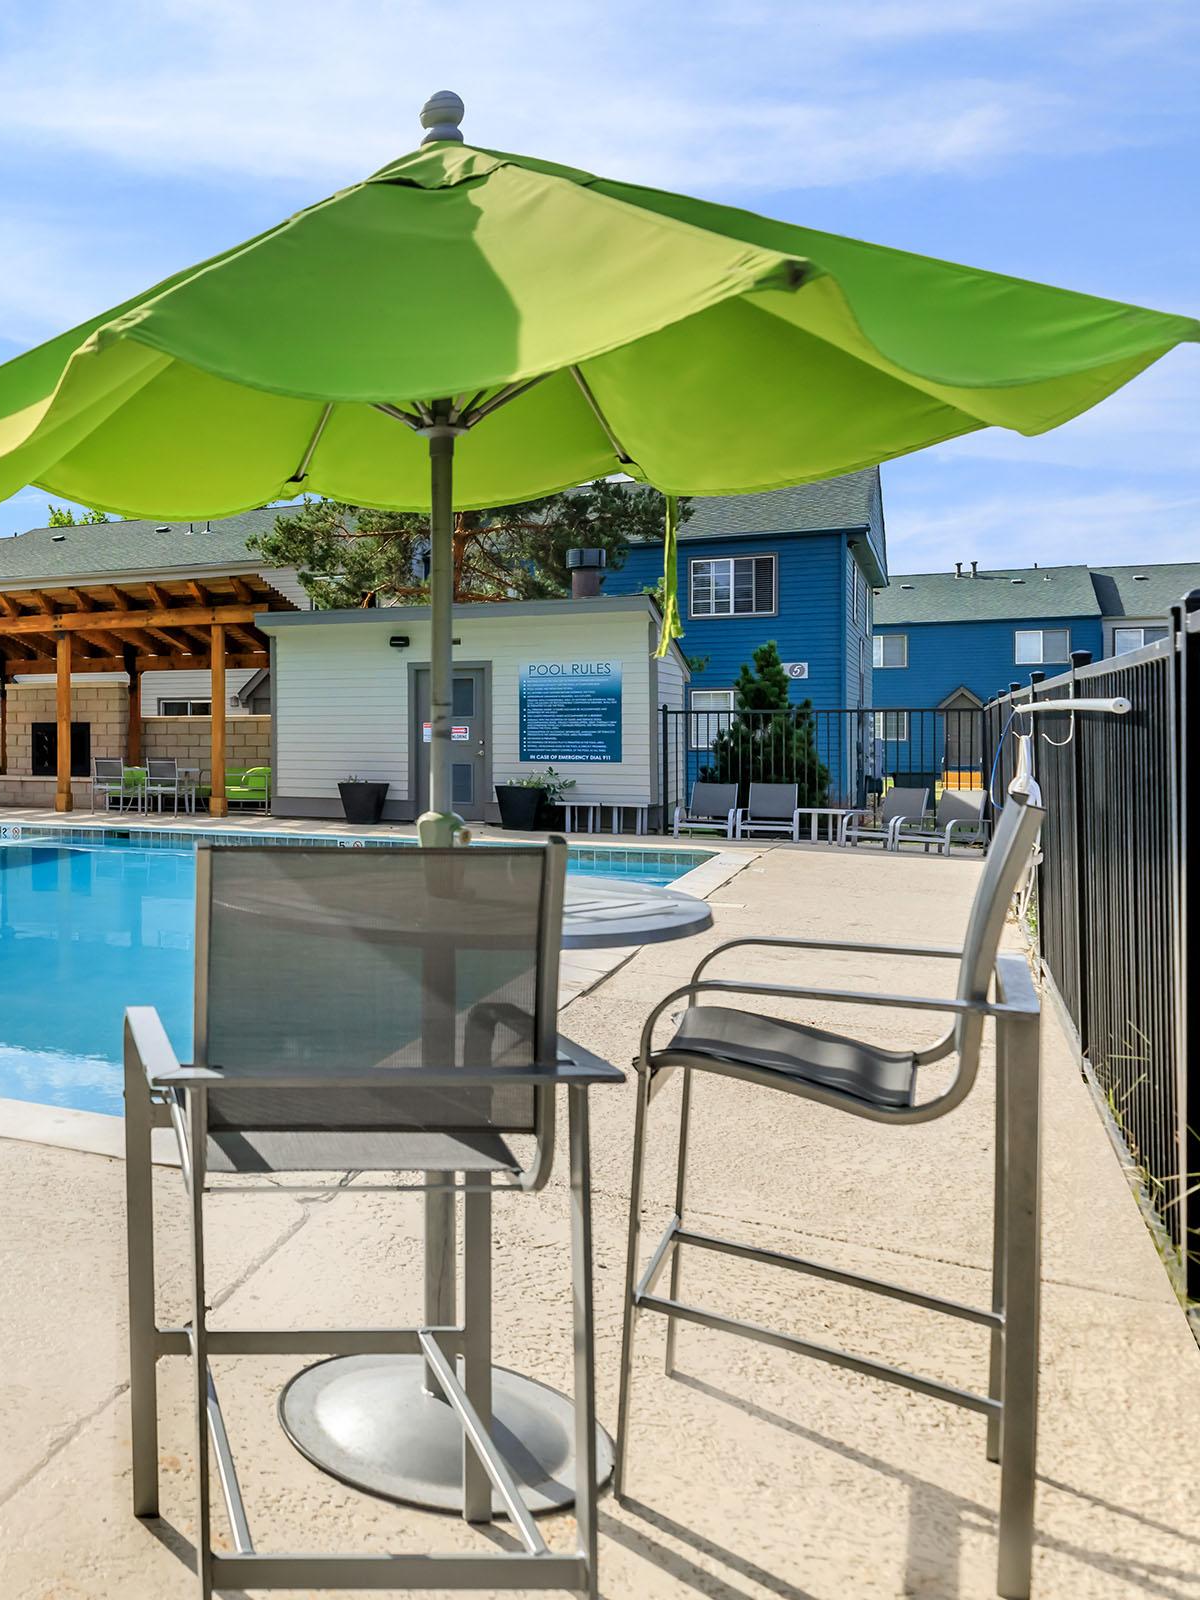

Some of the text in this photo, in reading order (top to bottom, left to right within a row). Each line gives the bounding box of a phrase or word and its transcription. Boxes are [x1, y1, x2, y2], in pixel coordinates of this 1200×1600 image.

[529, 663, 611, 675] POOL RULES
[792, 665, 802, 676] 5
